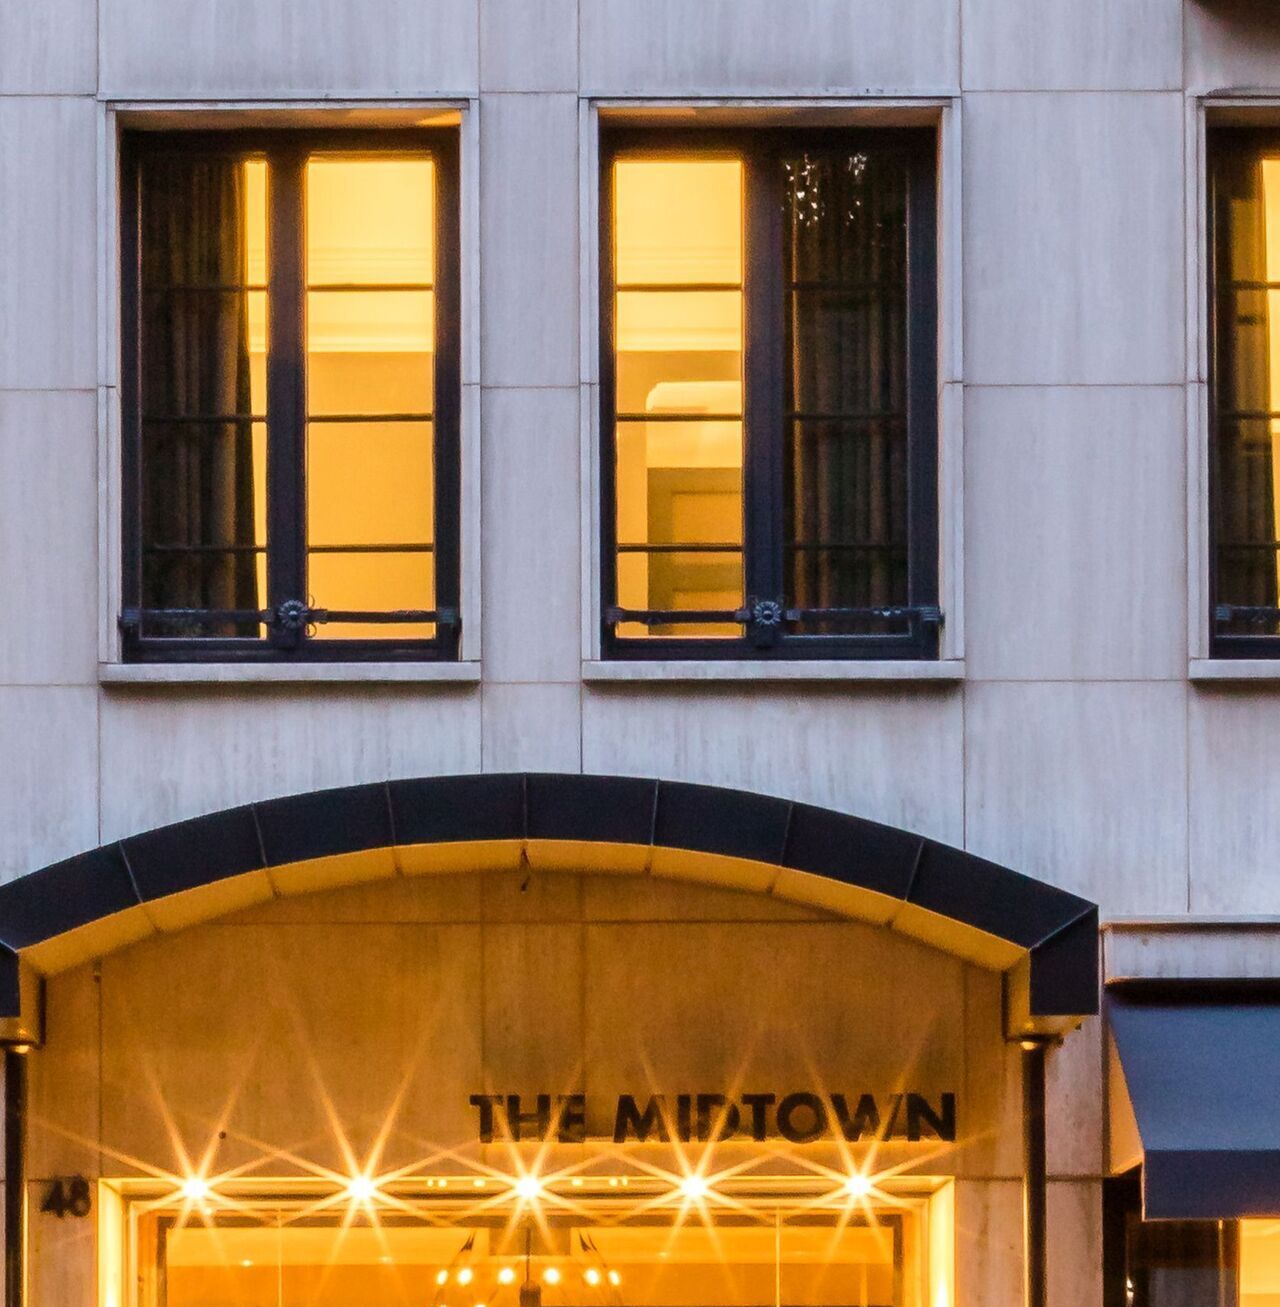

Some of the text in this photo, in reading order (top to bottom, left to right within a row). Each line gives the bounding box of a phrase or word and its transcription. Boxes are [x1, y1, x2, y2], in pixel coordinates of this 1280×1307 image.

[470, 1093, 956, 1143] THE MIDTOWN
[40, 1174, 91, 1218] 48
